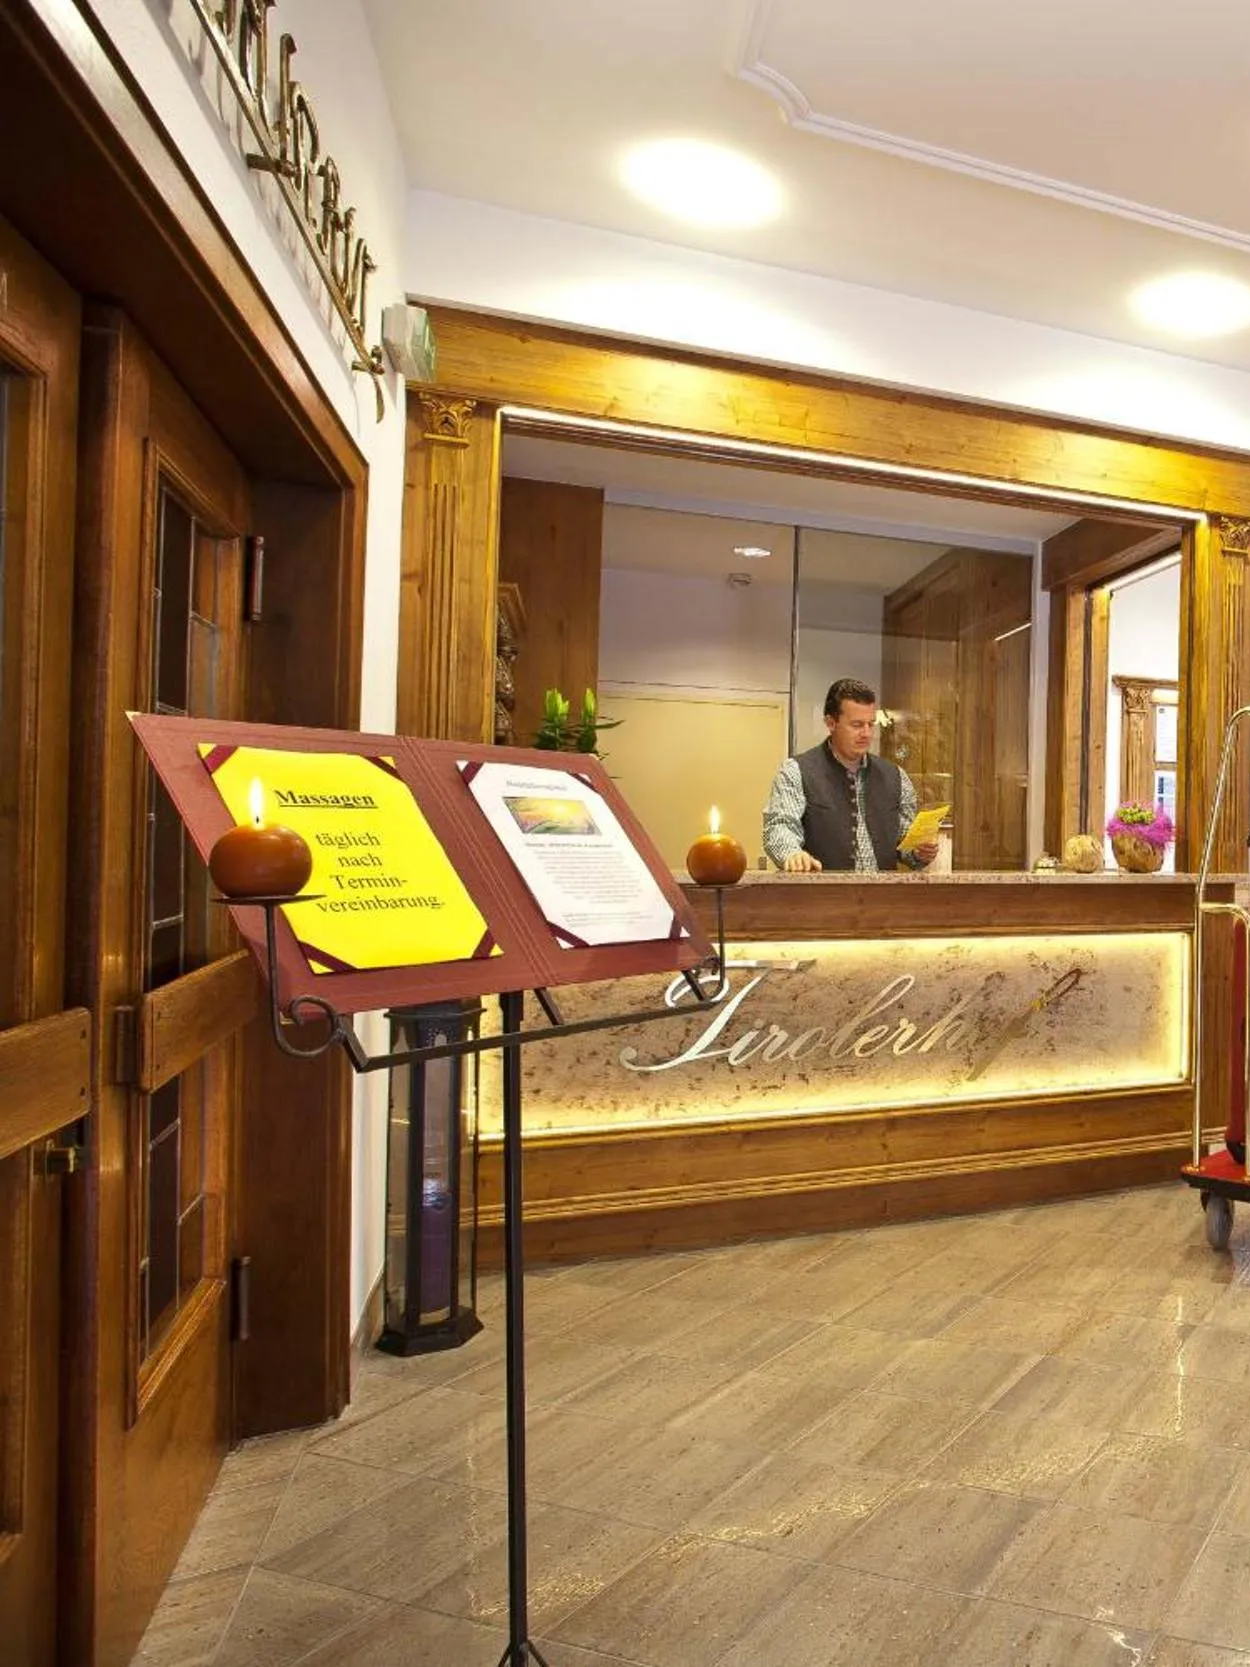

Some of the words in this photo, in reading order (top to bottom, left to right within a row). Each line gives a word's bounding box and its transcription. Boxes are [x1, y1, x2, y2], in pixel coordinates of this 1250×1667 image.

[274, 789, 378, 809] Massagen
[315, 832, 381, 849] täglich
[338, 852, 383, 868] nach
[329, 873, 408, 890] Termin-
[316, 894, 446, 912] vereinbarung.
